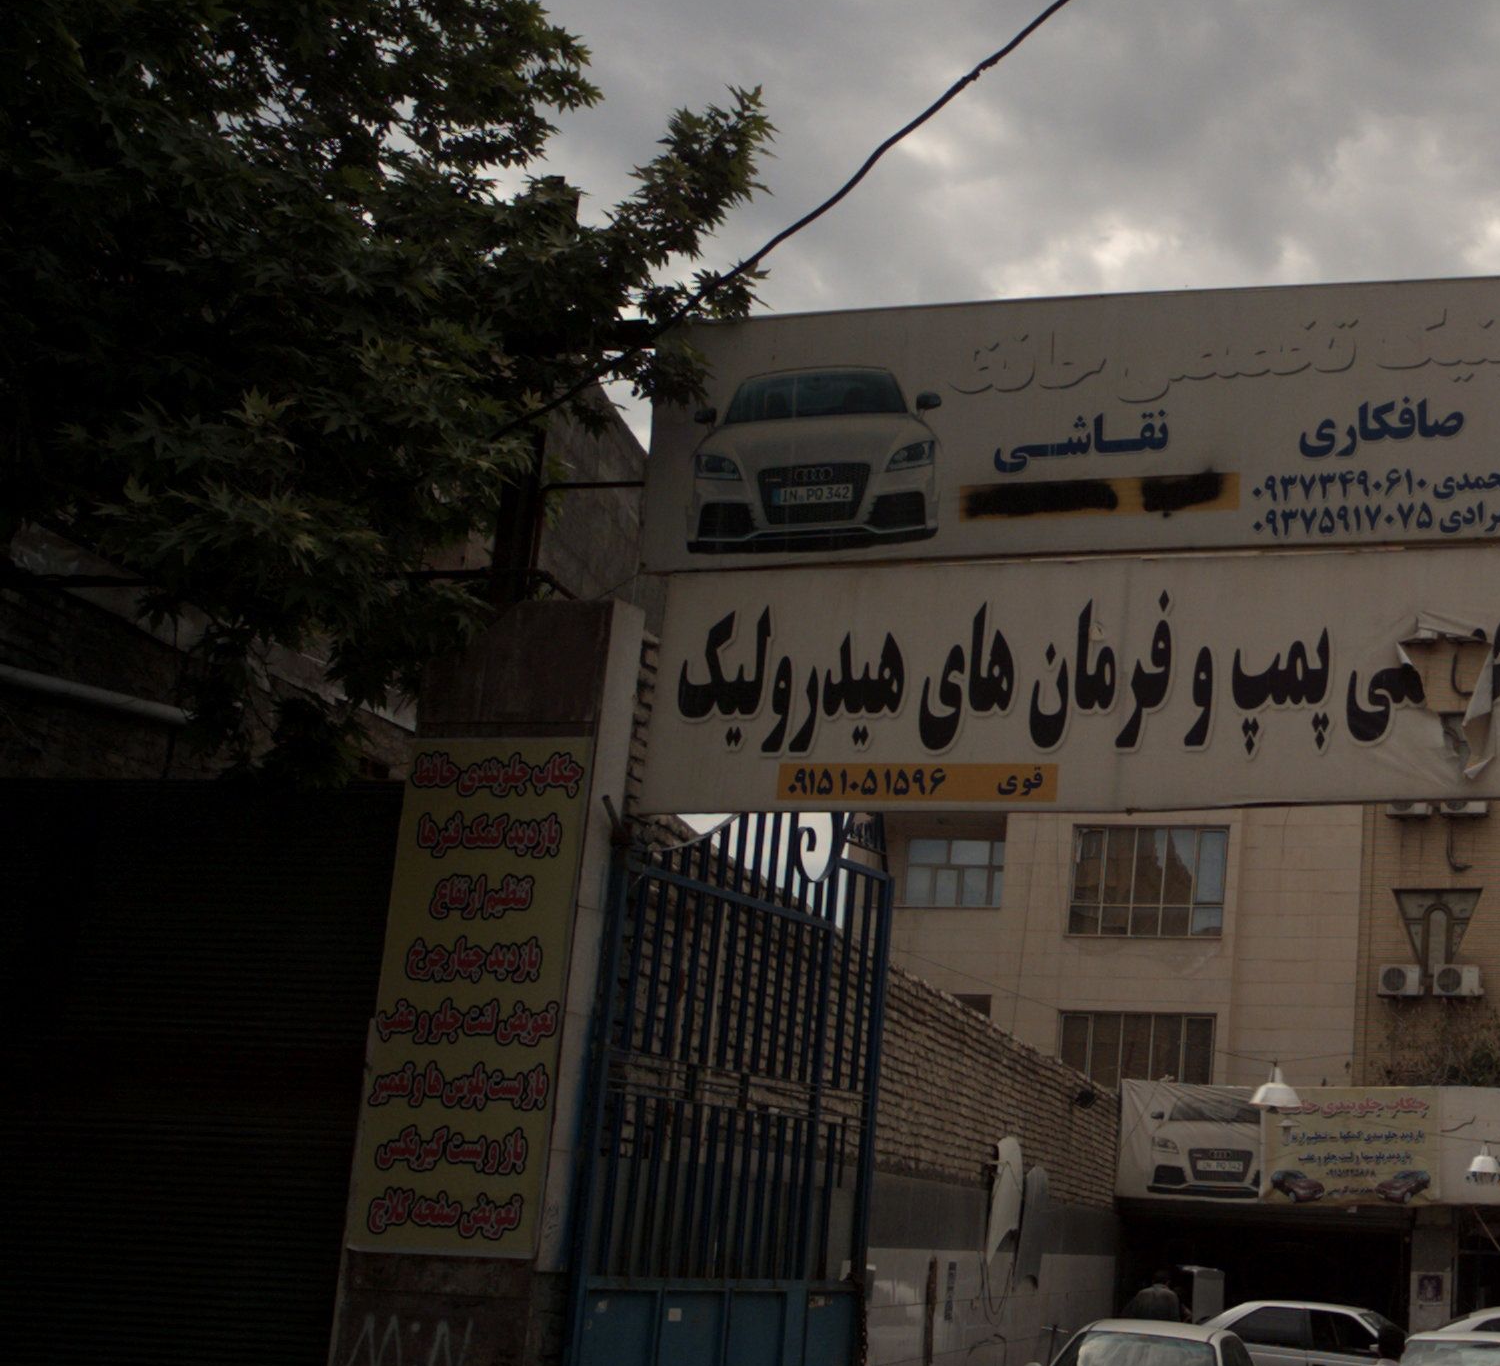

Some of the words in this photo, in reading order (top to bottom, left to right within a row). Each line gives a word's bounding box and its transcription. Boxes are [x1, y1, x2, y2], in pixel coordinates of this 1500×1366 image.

[993, 409, 1168, 473] نقاشی
[1300, 396, 1465, 459] صافکاری
[677, 604, 905, 753] هیدرولیک
[919, 602, 1014, 751] های
[1028, 589, 1173, 749] فرمان
[1233, 628, 1329, 754] پمپ
[1182, 643, 1214, 746] و
[506, 812, 562, 858] بازدید
[429, 874, 487, 919] ارتفاع
[483, 874, 534, 919] تنظیم
[486, 936, 542, 982] بازدید
[413, 1011, 430, 1044] و
[429, 998, 464, 1044] جلو
[464, 998, 499, 1036] لنت
[497, 1000, 559, 1046] تعویض
[446, 1133, 487, 1172] بست
[483, 1141, 499, 1173] و
[499, 1127, 528, 1174] باز
[411, 1191, 461, 1227] صفحه
[459, 1193, 523, 1240] تعویض
